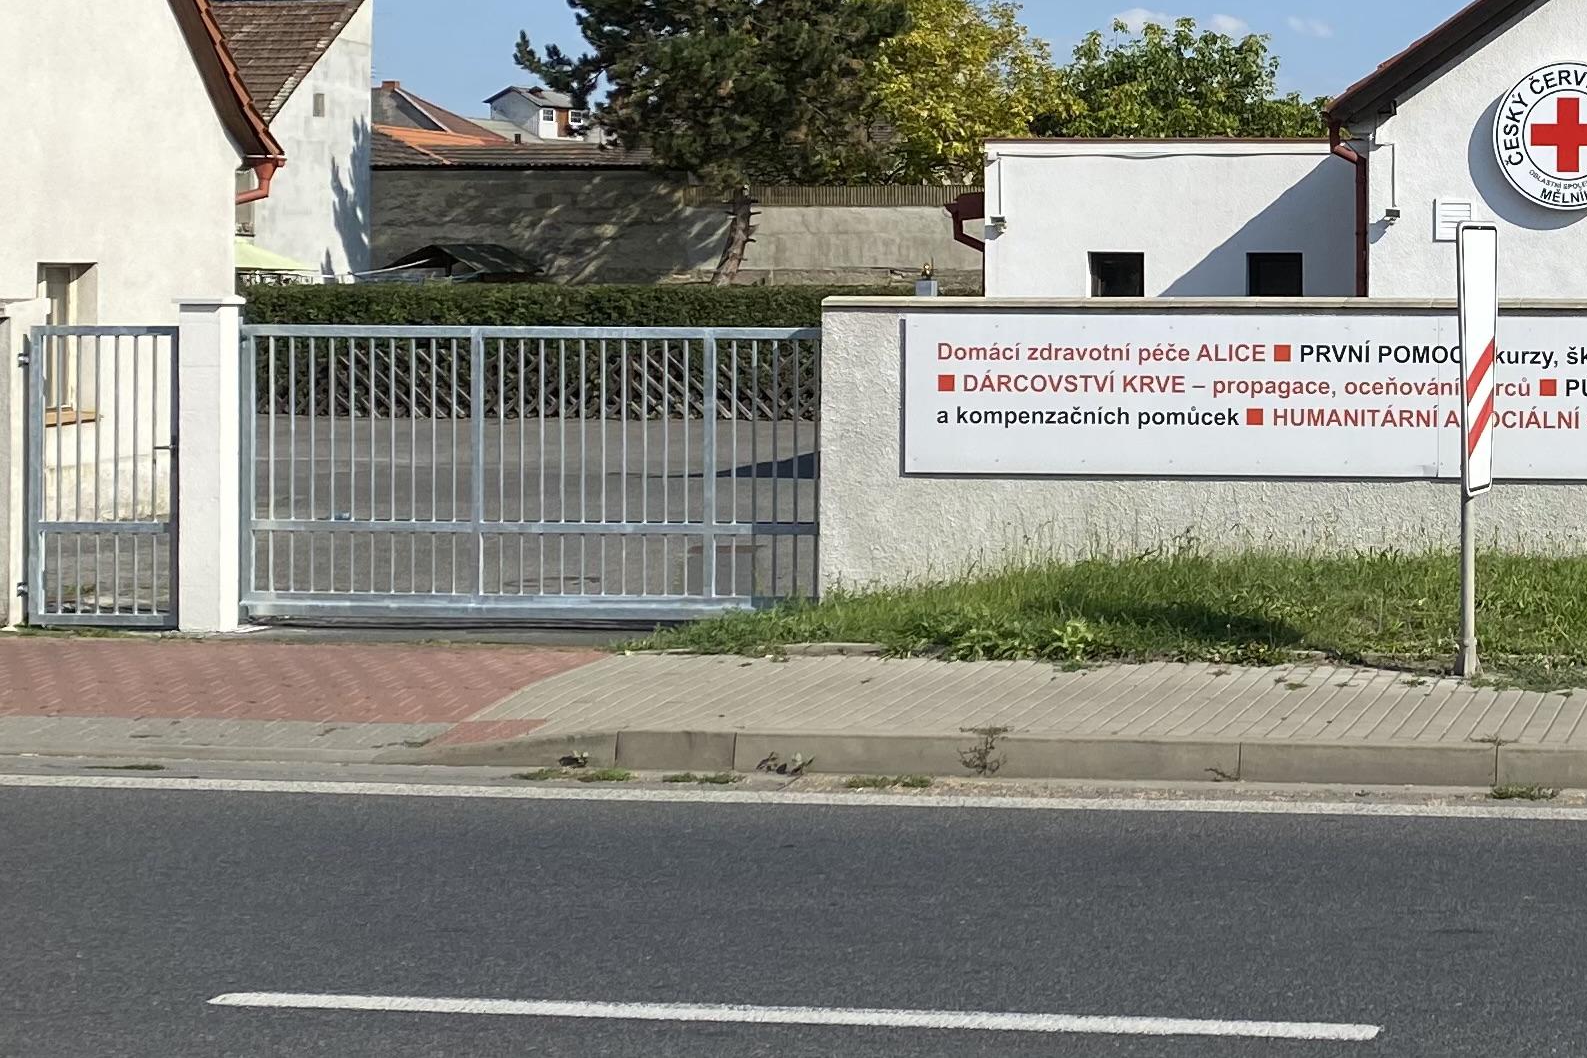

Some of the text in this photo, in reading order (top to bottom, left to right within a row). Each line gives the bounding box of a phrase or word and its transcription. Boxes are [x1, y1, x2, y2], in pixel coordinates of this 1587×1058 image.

[1503, 92, 1529, 167] ČESKÝ
[1528, 169, 1562, 189] OBLASTNÍ
[937, 342, 1266, 365] Domácí zdravotní péče ALICE
[1300, 340, 1371, 363] PRVNÍ
[1495, 346, 1558, 370] kurzy,
[964, 370, 1115, 393] DÁRCOVSTVÍ
[1122, 374, 1186, 394] KRVE
[1213, 377, 1336, 399] propagace,
[1344, 376, 1460, 396] oceňování
[1495, 376, 1531, 397] rců
[936, 405, 1240, 429] a kompenzačních pomůcek
[1273, 404, 1439, 428] HUMANITÁRNÍ
[1443, 409, 1460, 428] A
